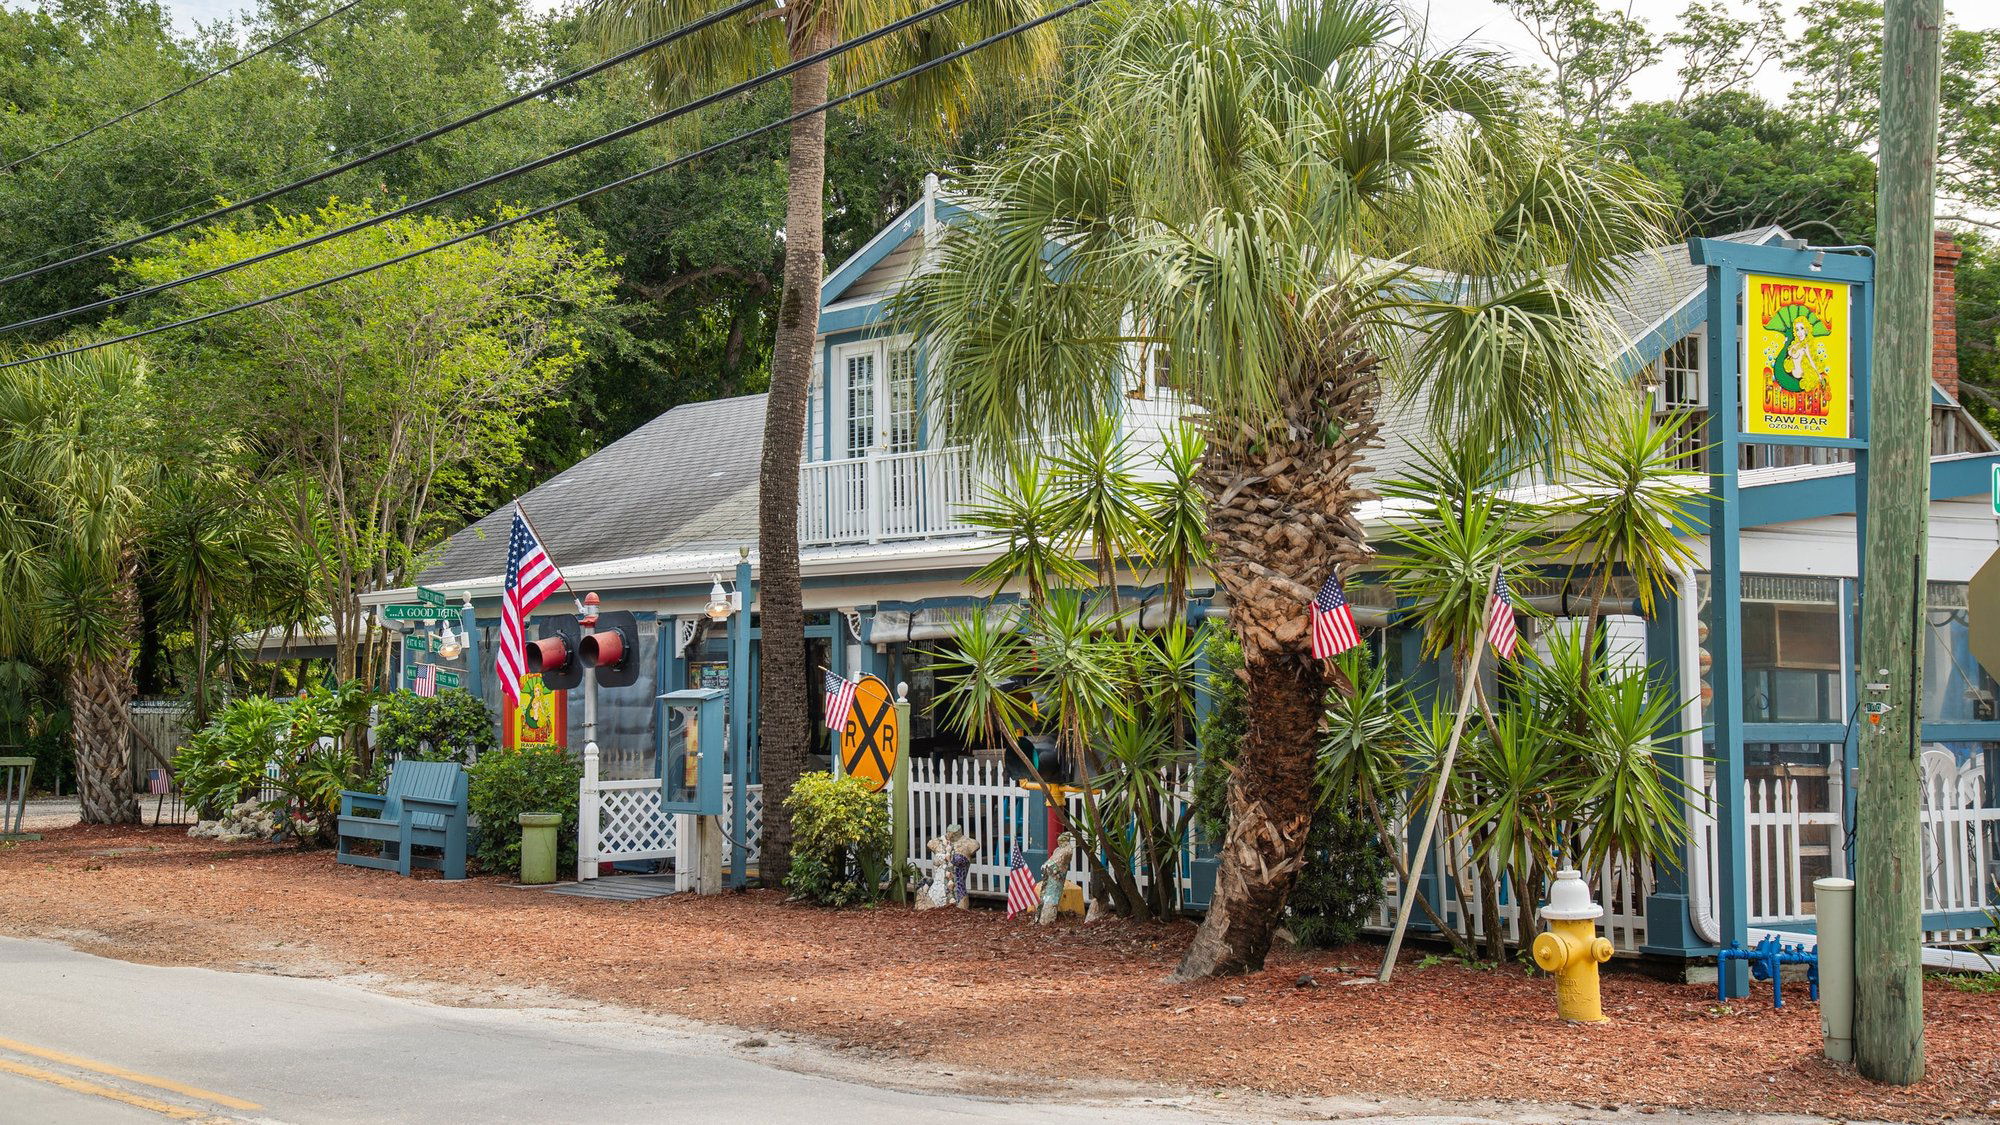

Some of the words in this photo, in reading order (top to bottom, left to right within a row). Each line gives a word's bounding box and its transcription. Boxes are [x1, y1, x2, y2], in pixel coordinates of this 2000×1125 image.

[1761, 283, 1833, 330] MOLLY
[1764, 415, 1795, 423] RAW
[1800, 417, 1827, 425] BAR
[407, 608, 434, 617] GOOD
[436, 609, 462, 618] THIN
